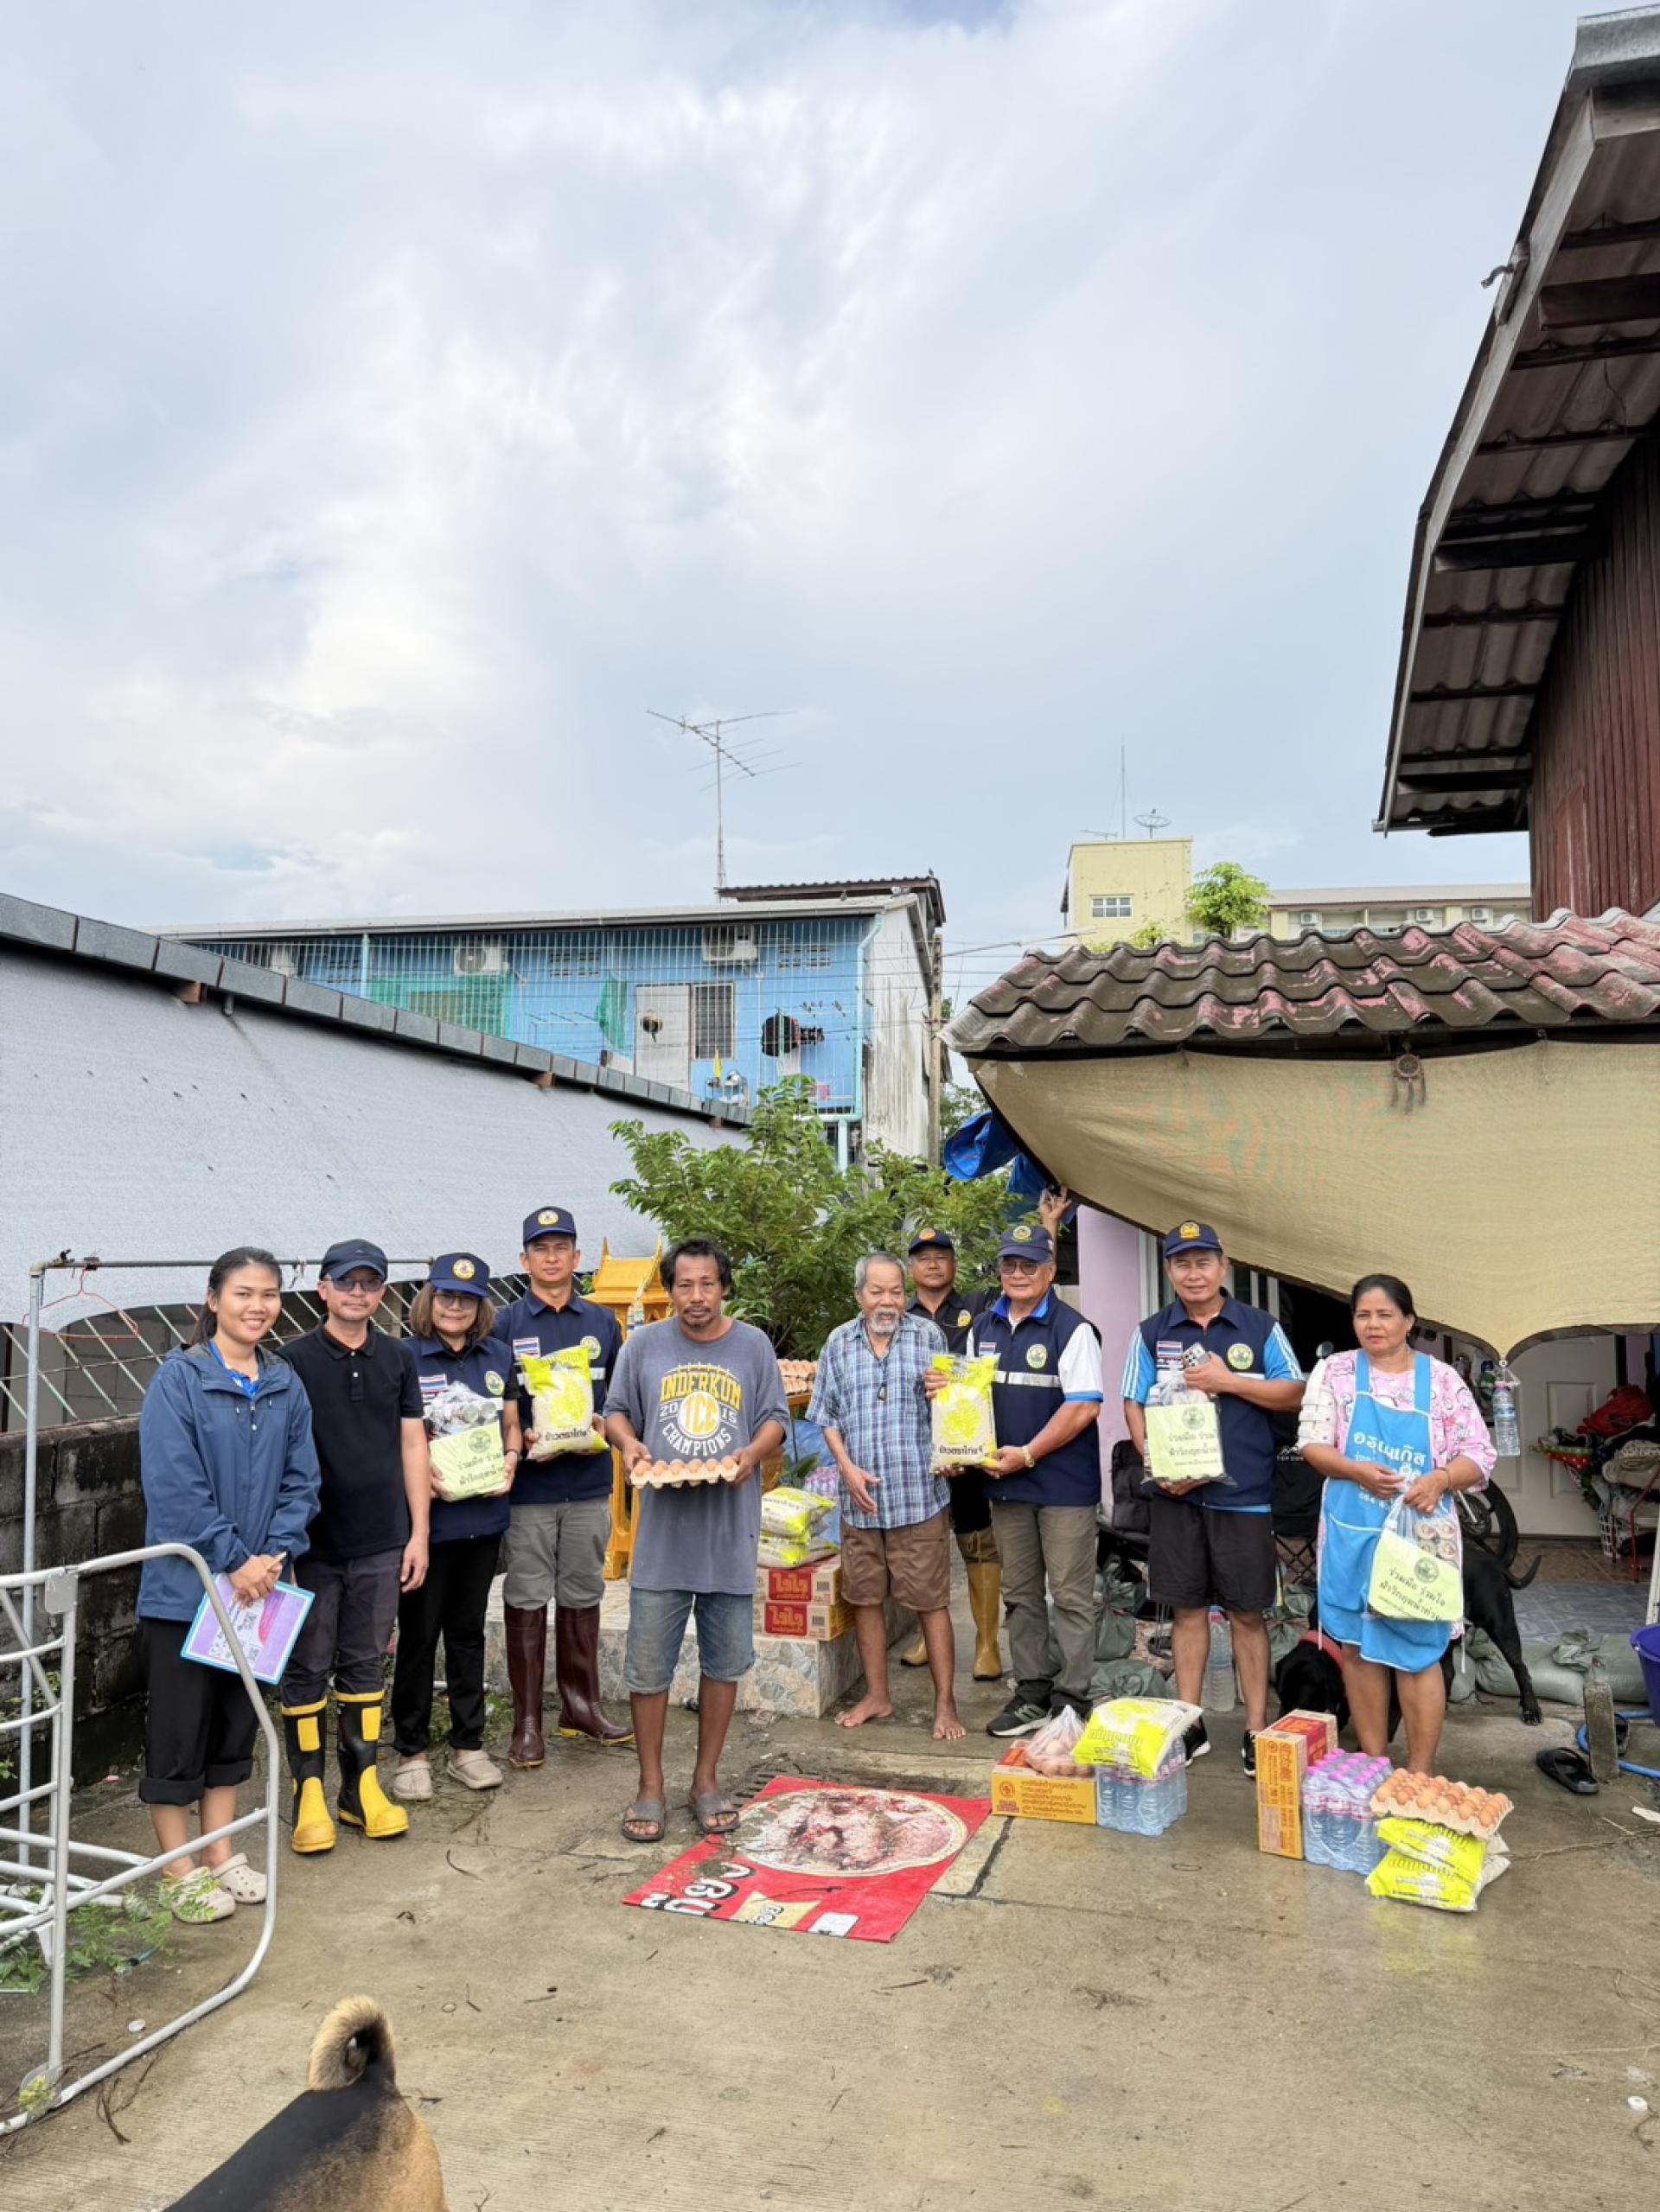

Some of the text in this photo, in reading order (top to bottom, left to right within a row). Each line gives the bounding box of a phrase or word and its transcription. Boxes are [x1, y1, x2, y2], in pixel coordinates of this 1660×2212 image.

[660, 1401, 679, 1418] 20
[720, 1406, 737, 1425] 15
[661, 1422, 732, 1457] CHAMPIONS
